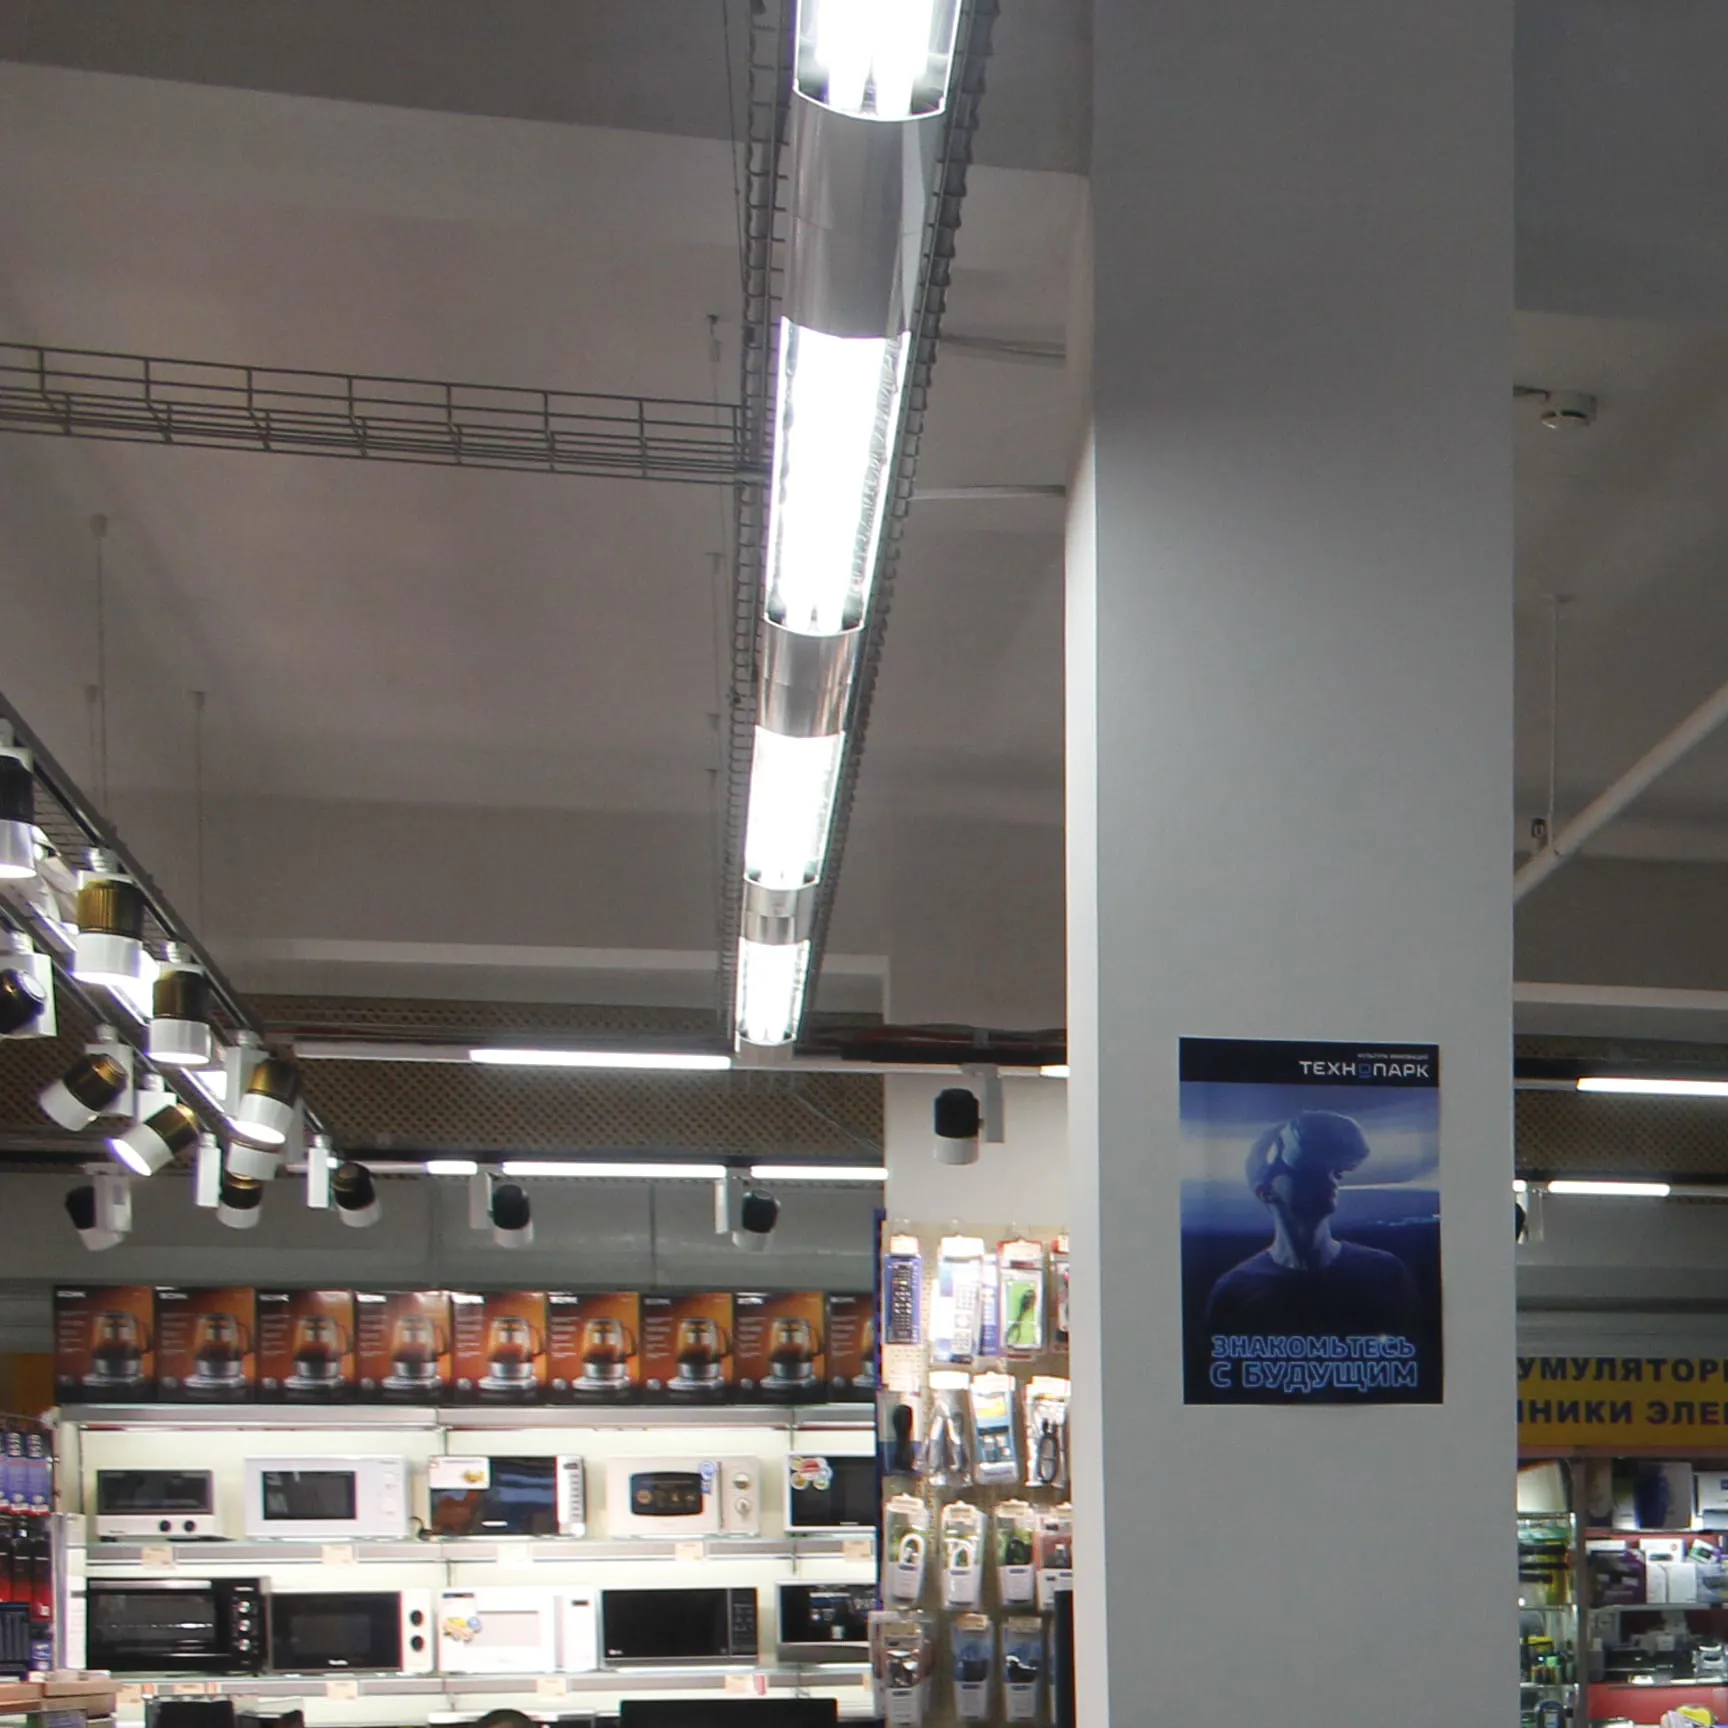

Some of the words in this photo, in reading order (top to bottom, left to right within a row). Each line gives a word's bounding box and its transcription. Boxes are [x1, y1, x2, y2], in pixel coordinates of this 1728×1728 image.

[1299, 1060, 1429, 1078] ТЕХНОПАРК
[1211, 1335, 1415, 1358] ЗНАКОМЬТЕСЬ
[1210, 1361, 1231, 1387] С
[1242, 1360, 1417, 1392] БУДУЩИМ
